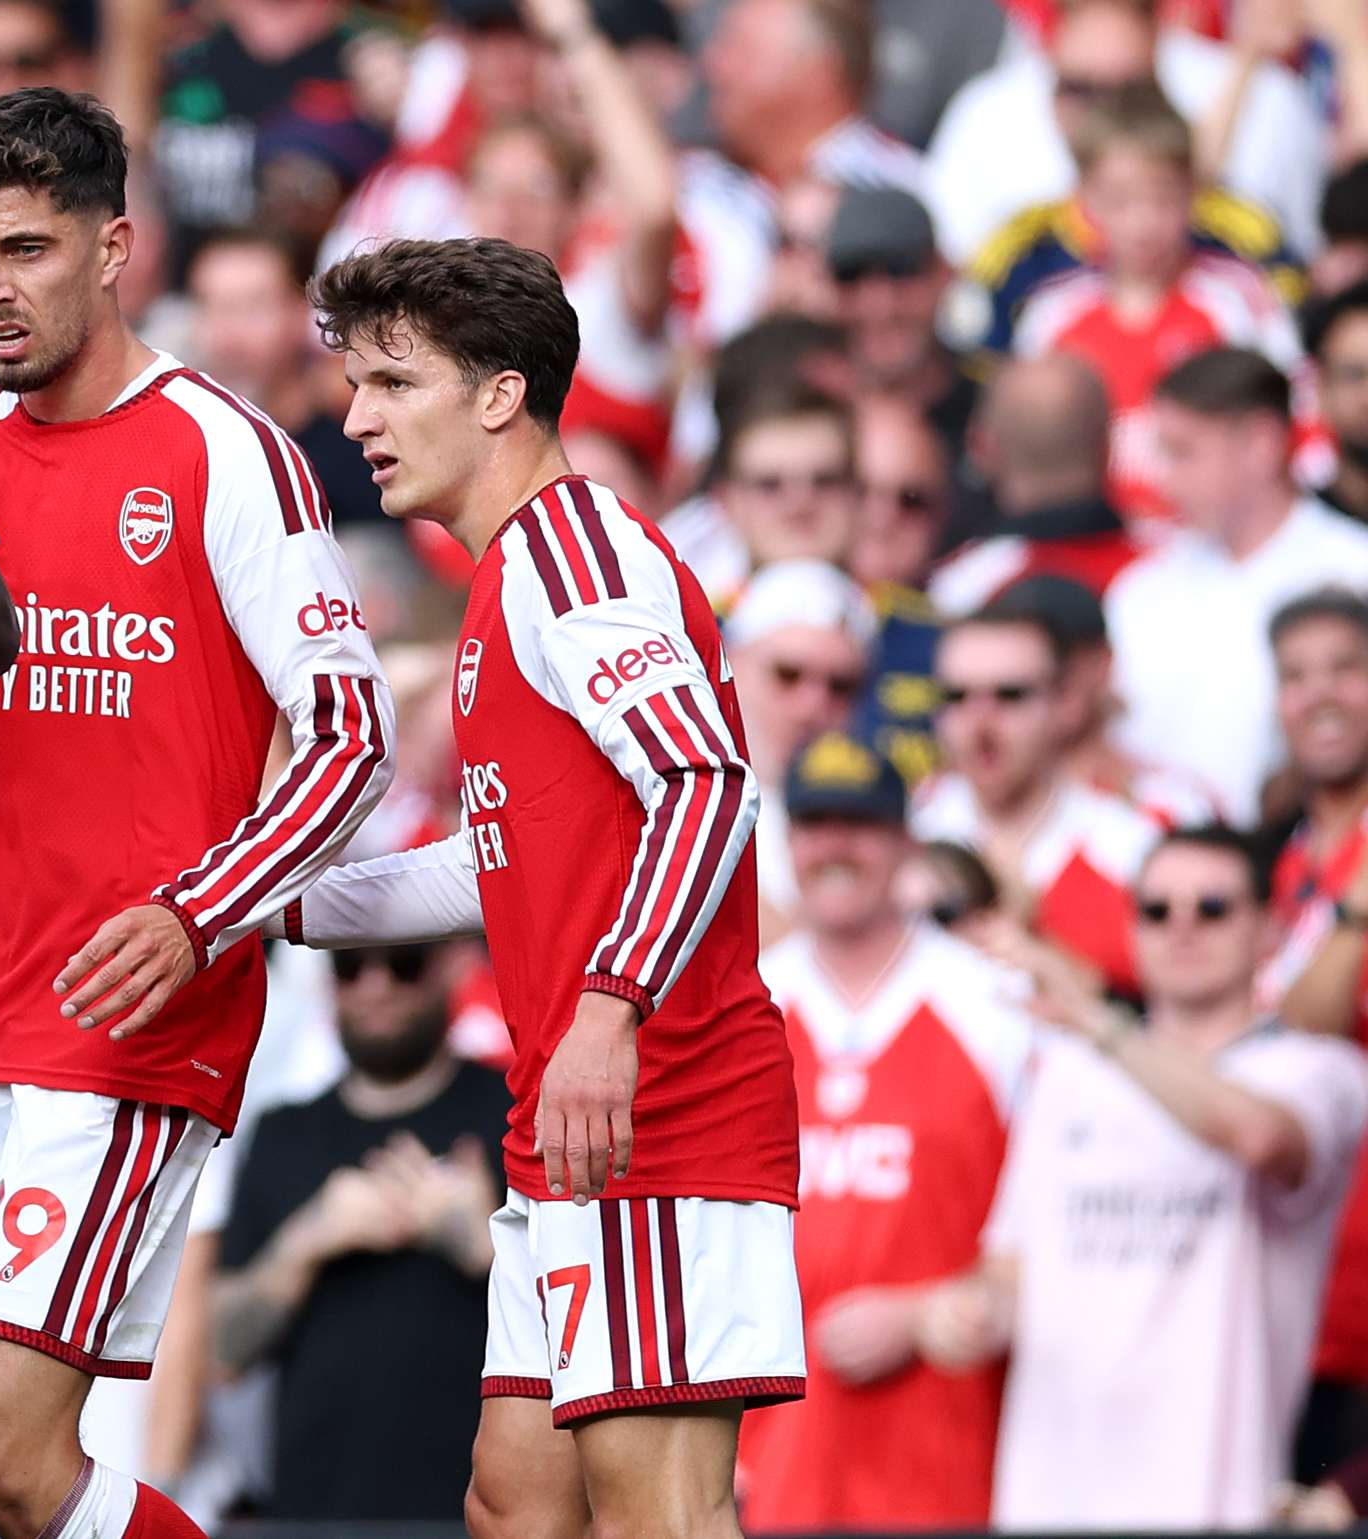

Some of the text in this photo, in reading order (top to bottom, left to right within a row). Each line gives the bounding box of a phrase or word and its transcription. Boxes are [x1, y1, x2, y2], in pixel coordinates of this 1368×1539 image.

[14, 592, 176, 664] irates
[297, 591, 367, 637] dee
[29, 665, 132, 719] BETTER
[468, 821, 510, 875] TER
